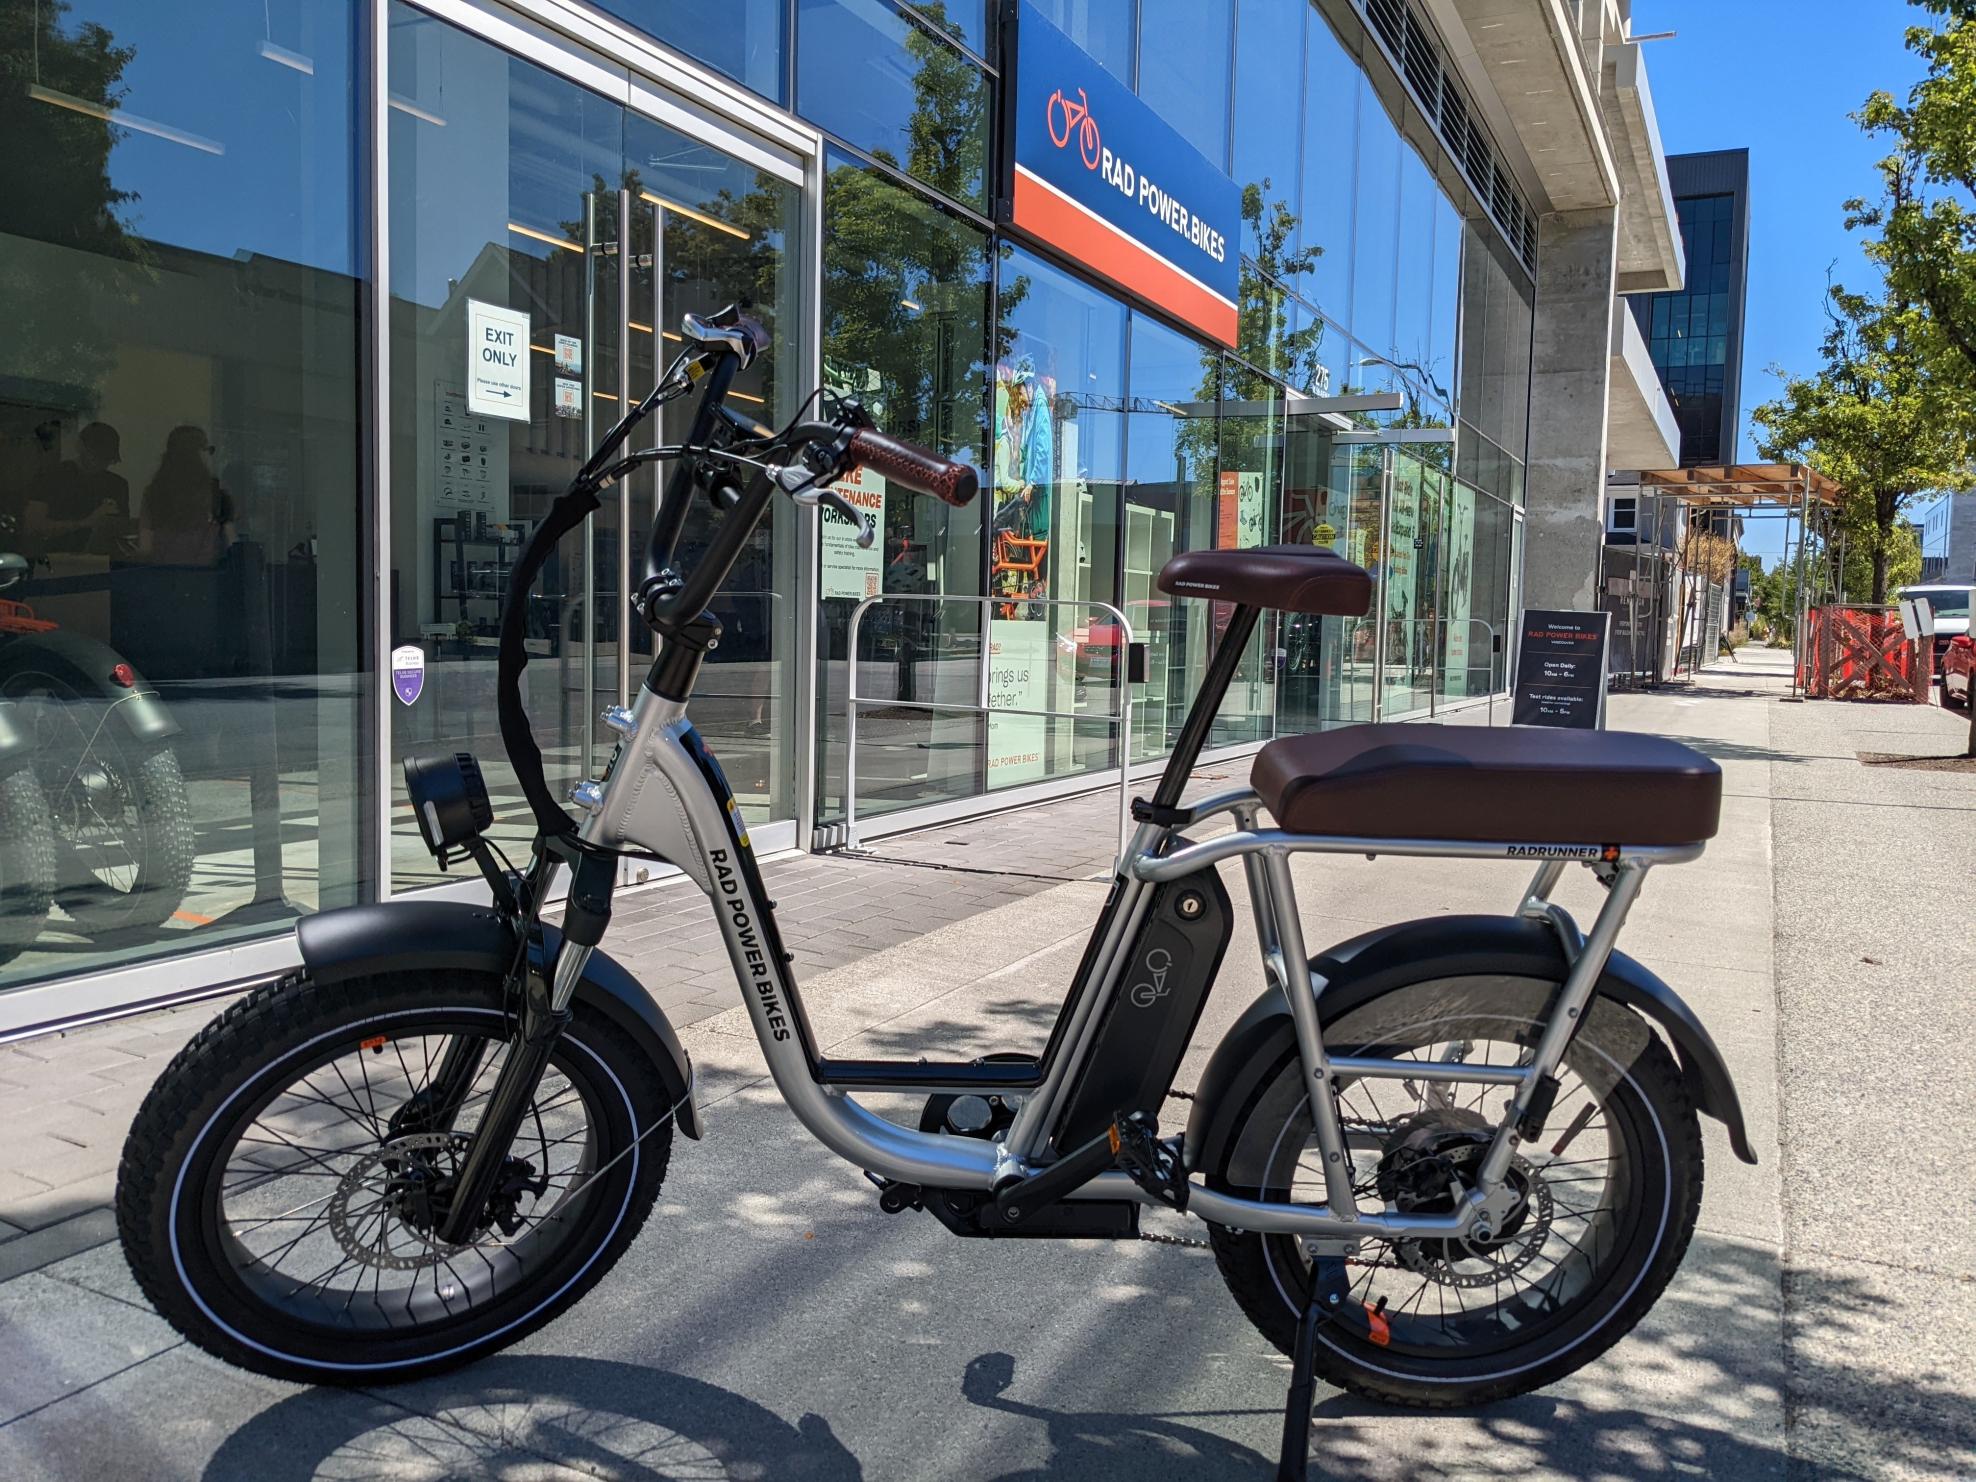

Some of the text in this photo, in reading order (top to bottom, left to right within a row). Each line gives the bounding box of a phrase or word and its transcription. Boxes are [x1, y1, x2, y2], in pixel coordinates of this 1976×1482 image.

[1102, 146, 1135, 198] RAD
[485, 327, 514, 346] EXIT
[482, 347, 518, 368] ONLY
[1315, 364, 1329, 391] 275
[1017, 669, 1029, 682] us
[988, 752, 1038, 768] RAD POWER BIKES
[1507, 845, 1598, 857] RADRUNNER
[709, 849, 738, 894] RAD
[727, 898, 767, 977] POWER
[756, 980, 790, 1041] BIKES
